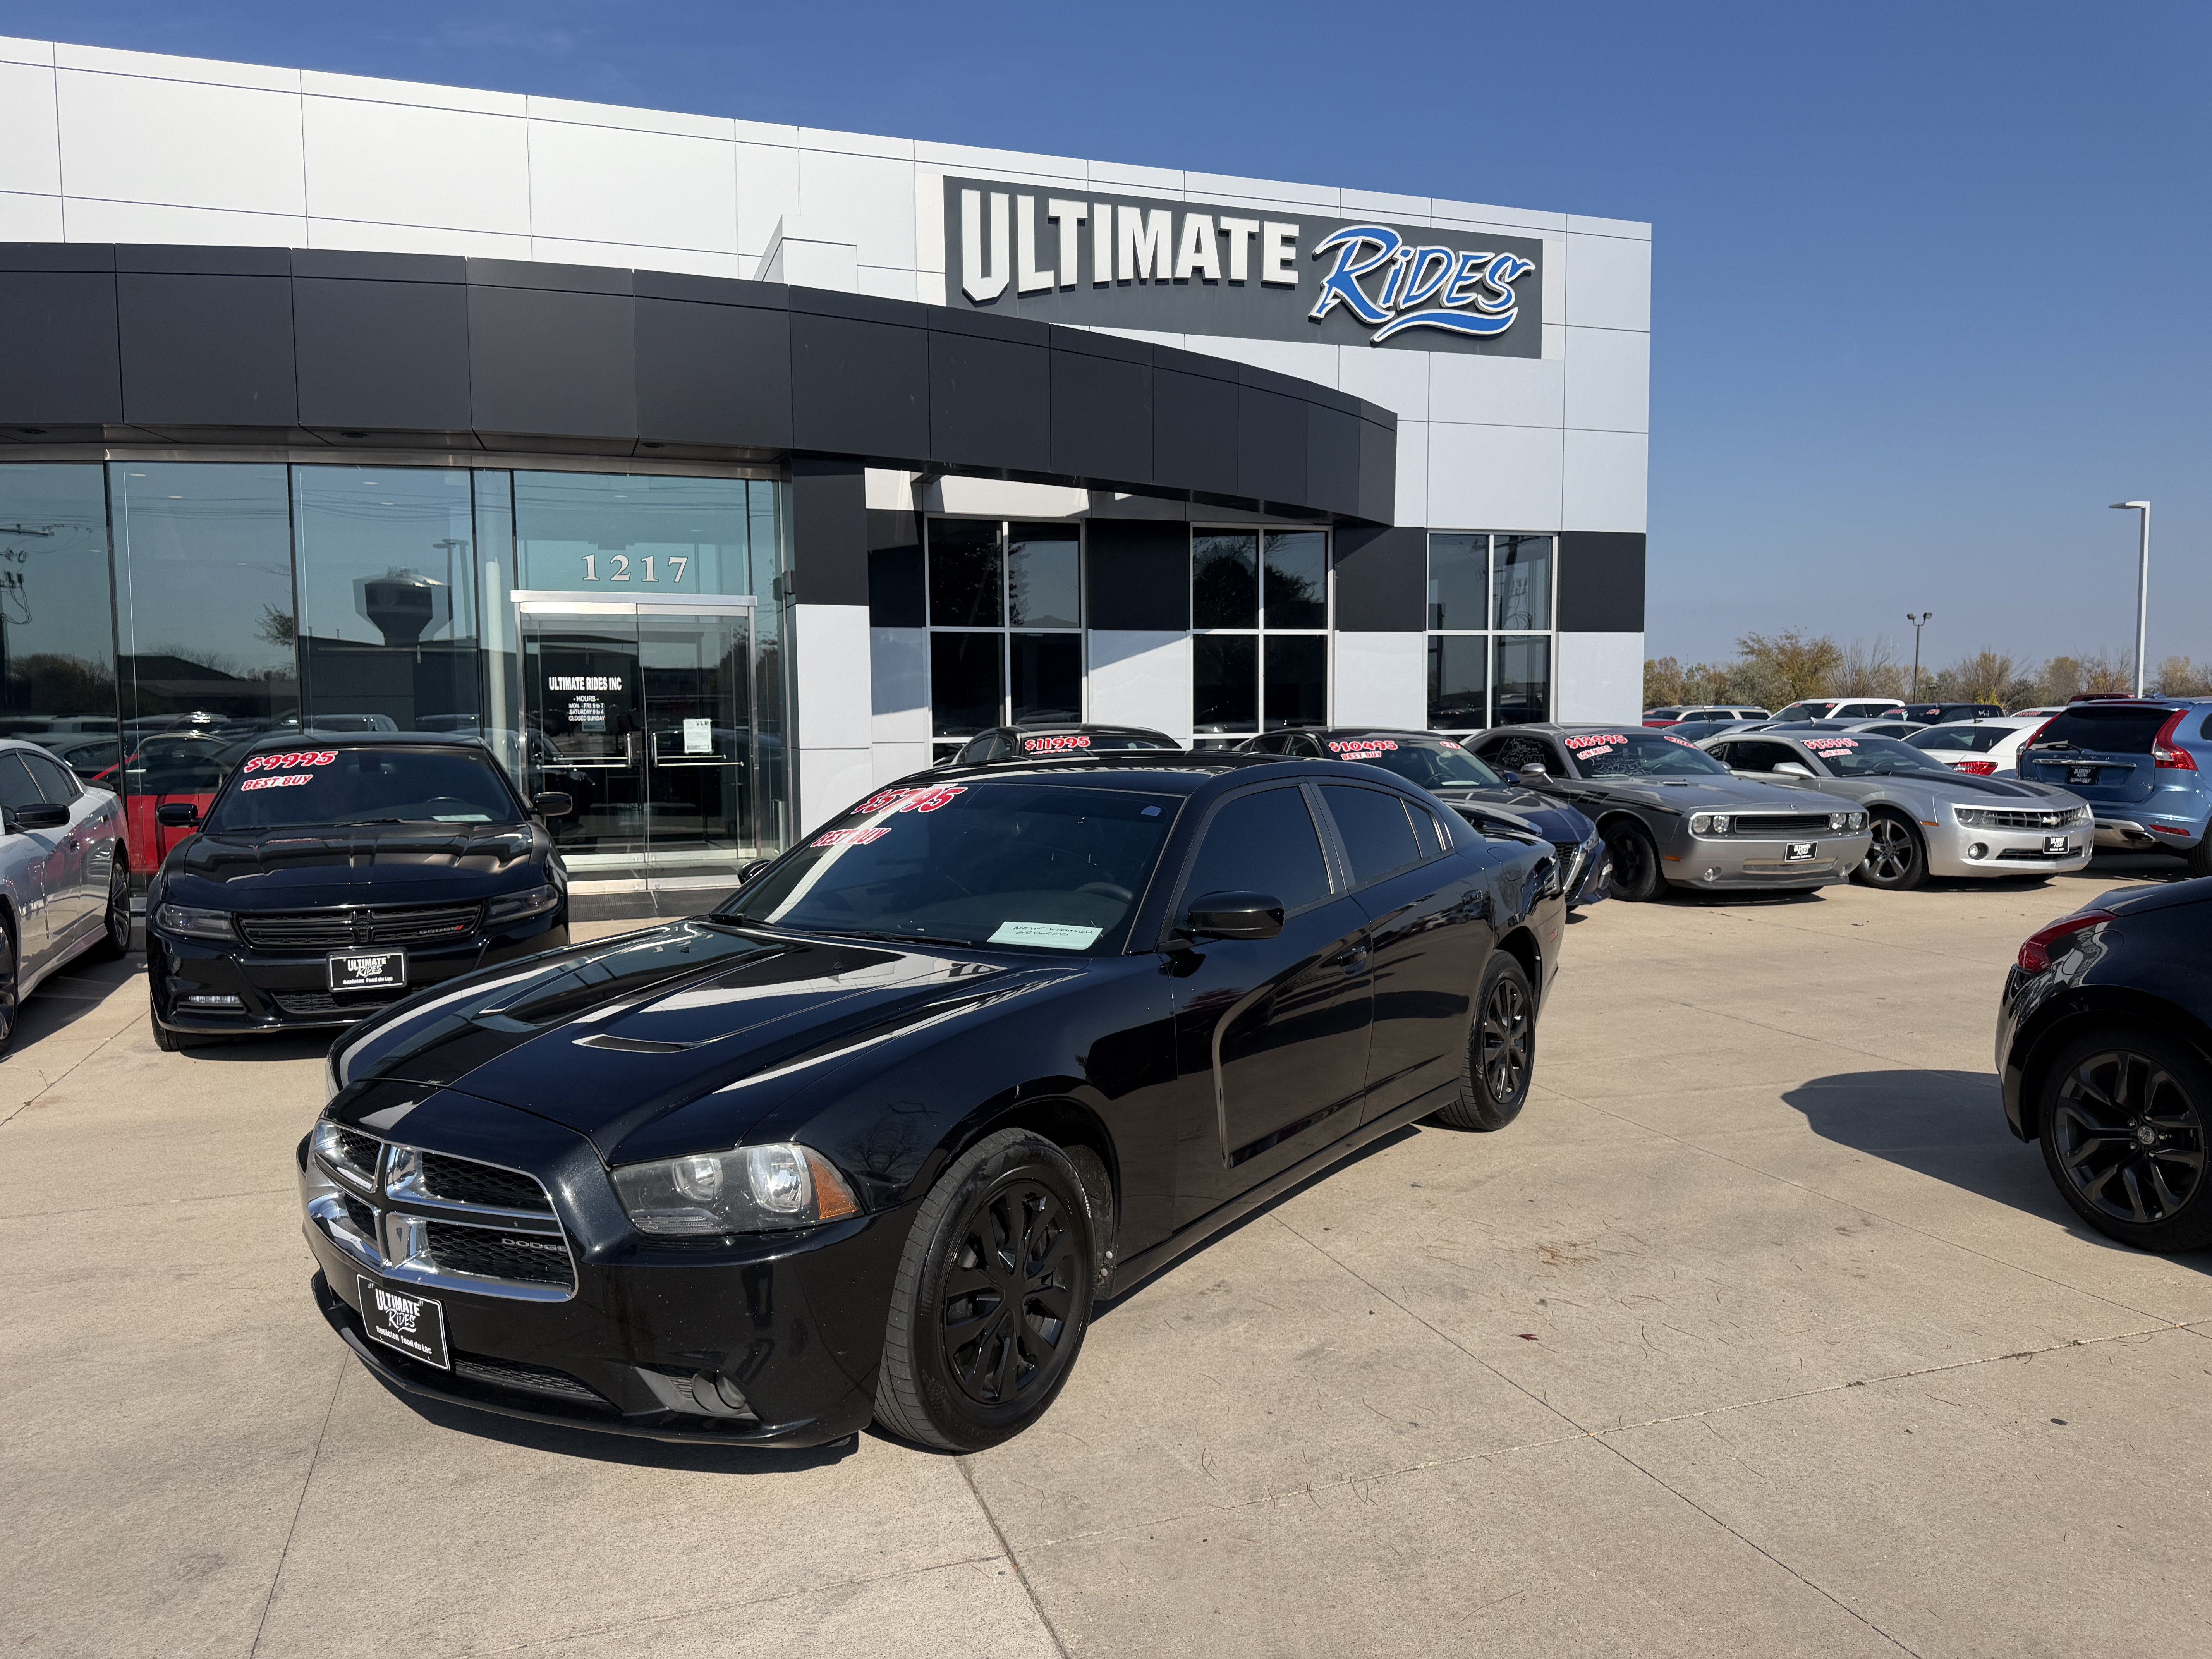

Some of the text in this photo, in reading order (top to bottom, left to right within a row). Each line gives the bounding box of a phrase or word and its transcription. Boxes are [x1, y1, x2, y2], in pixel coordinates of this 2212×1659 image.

[961, 189, 1300, 301] ULTIMATE
[582, 554, 688, 582] 1217
[548, 677, 622, 690] ULTIMATE RIDES INC
[1025, 736, 1091, 751] $11995
[1328, 740, 1398, 752] $10495
[243, 750, 338, 773] $9995
[1340, 752, 1363, 761] BEST
[1577, 750, 1592, 760] LOW
[242, 774, 313, 791] BEST BUY
[851, 787, 968, 814] $5795
[810, 828, 892, 848] BEST BUY
[348, 957, 386, 971] ULTIMATE
[502, 1238, 568, 1252] DODGE
[375, 1288, 420, 1316] ULTIMATE
[376, 1325, 432, 1355] Appleton Fond du Lac
